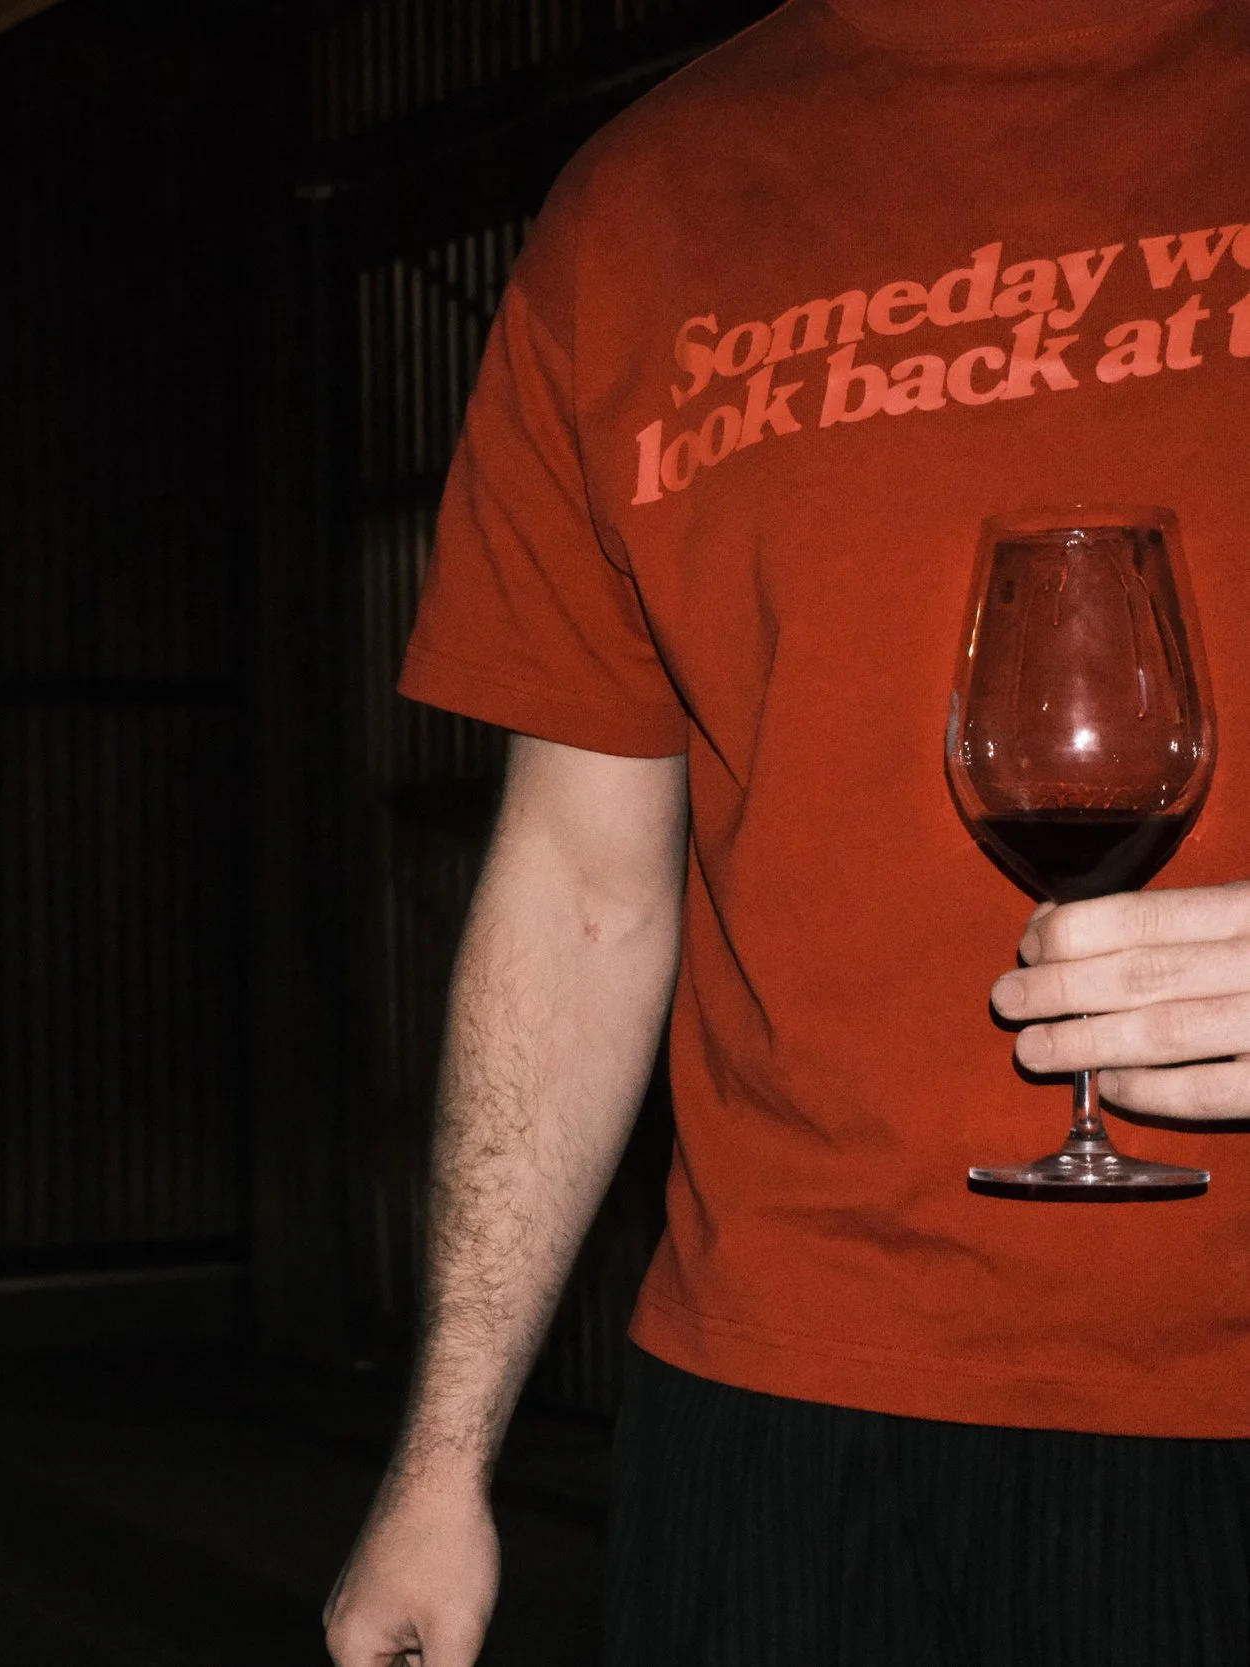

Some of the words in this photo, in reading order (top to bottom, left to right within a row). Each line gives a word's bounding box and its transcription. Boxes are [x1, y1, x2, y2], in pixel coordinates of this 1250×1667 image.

[631, 364, 803, 504] look
[819, 312, 1079, 428] back
[1096, 294, 1210, 383] at
[671, 242, 1124, 408] Someday
